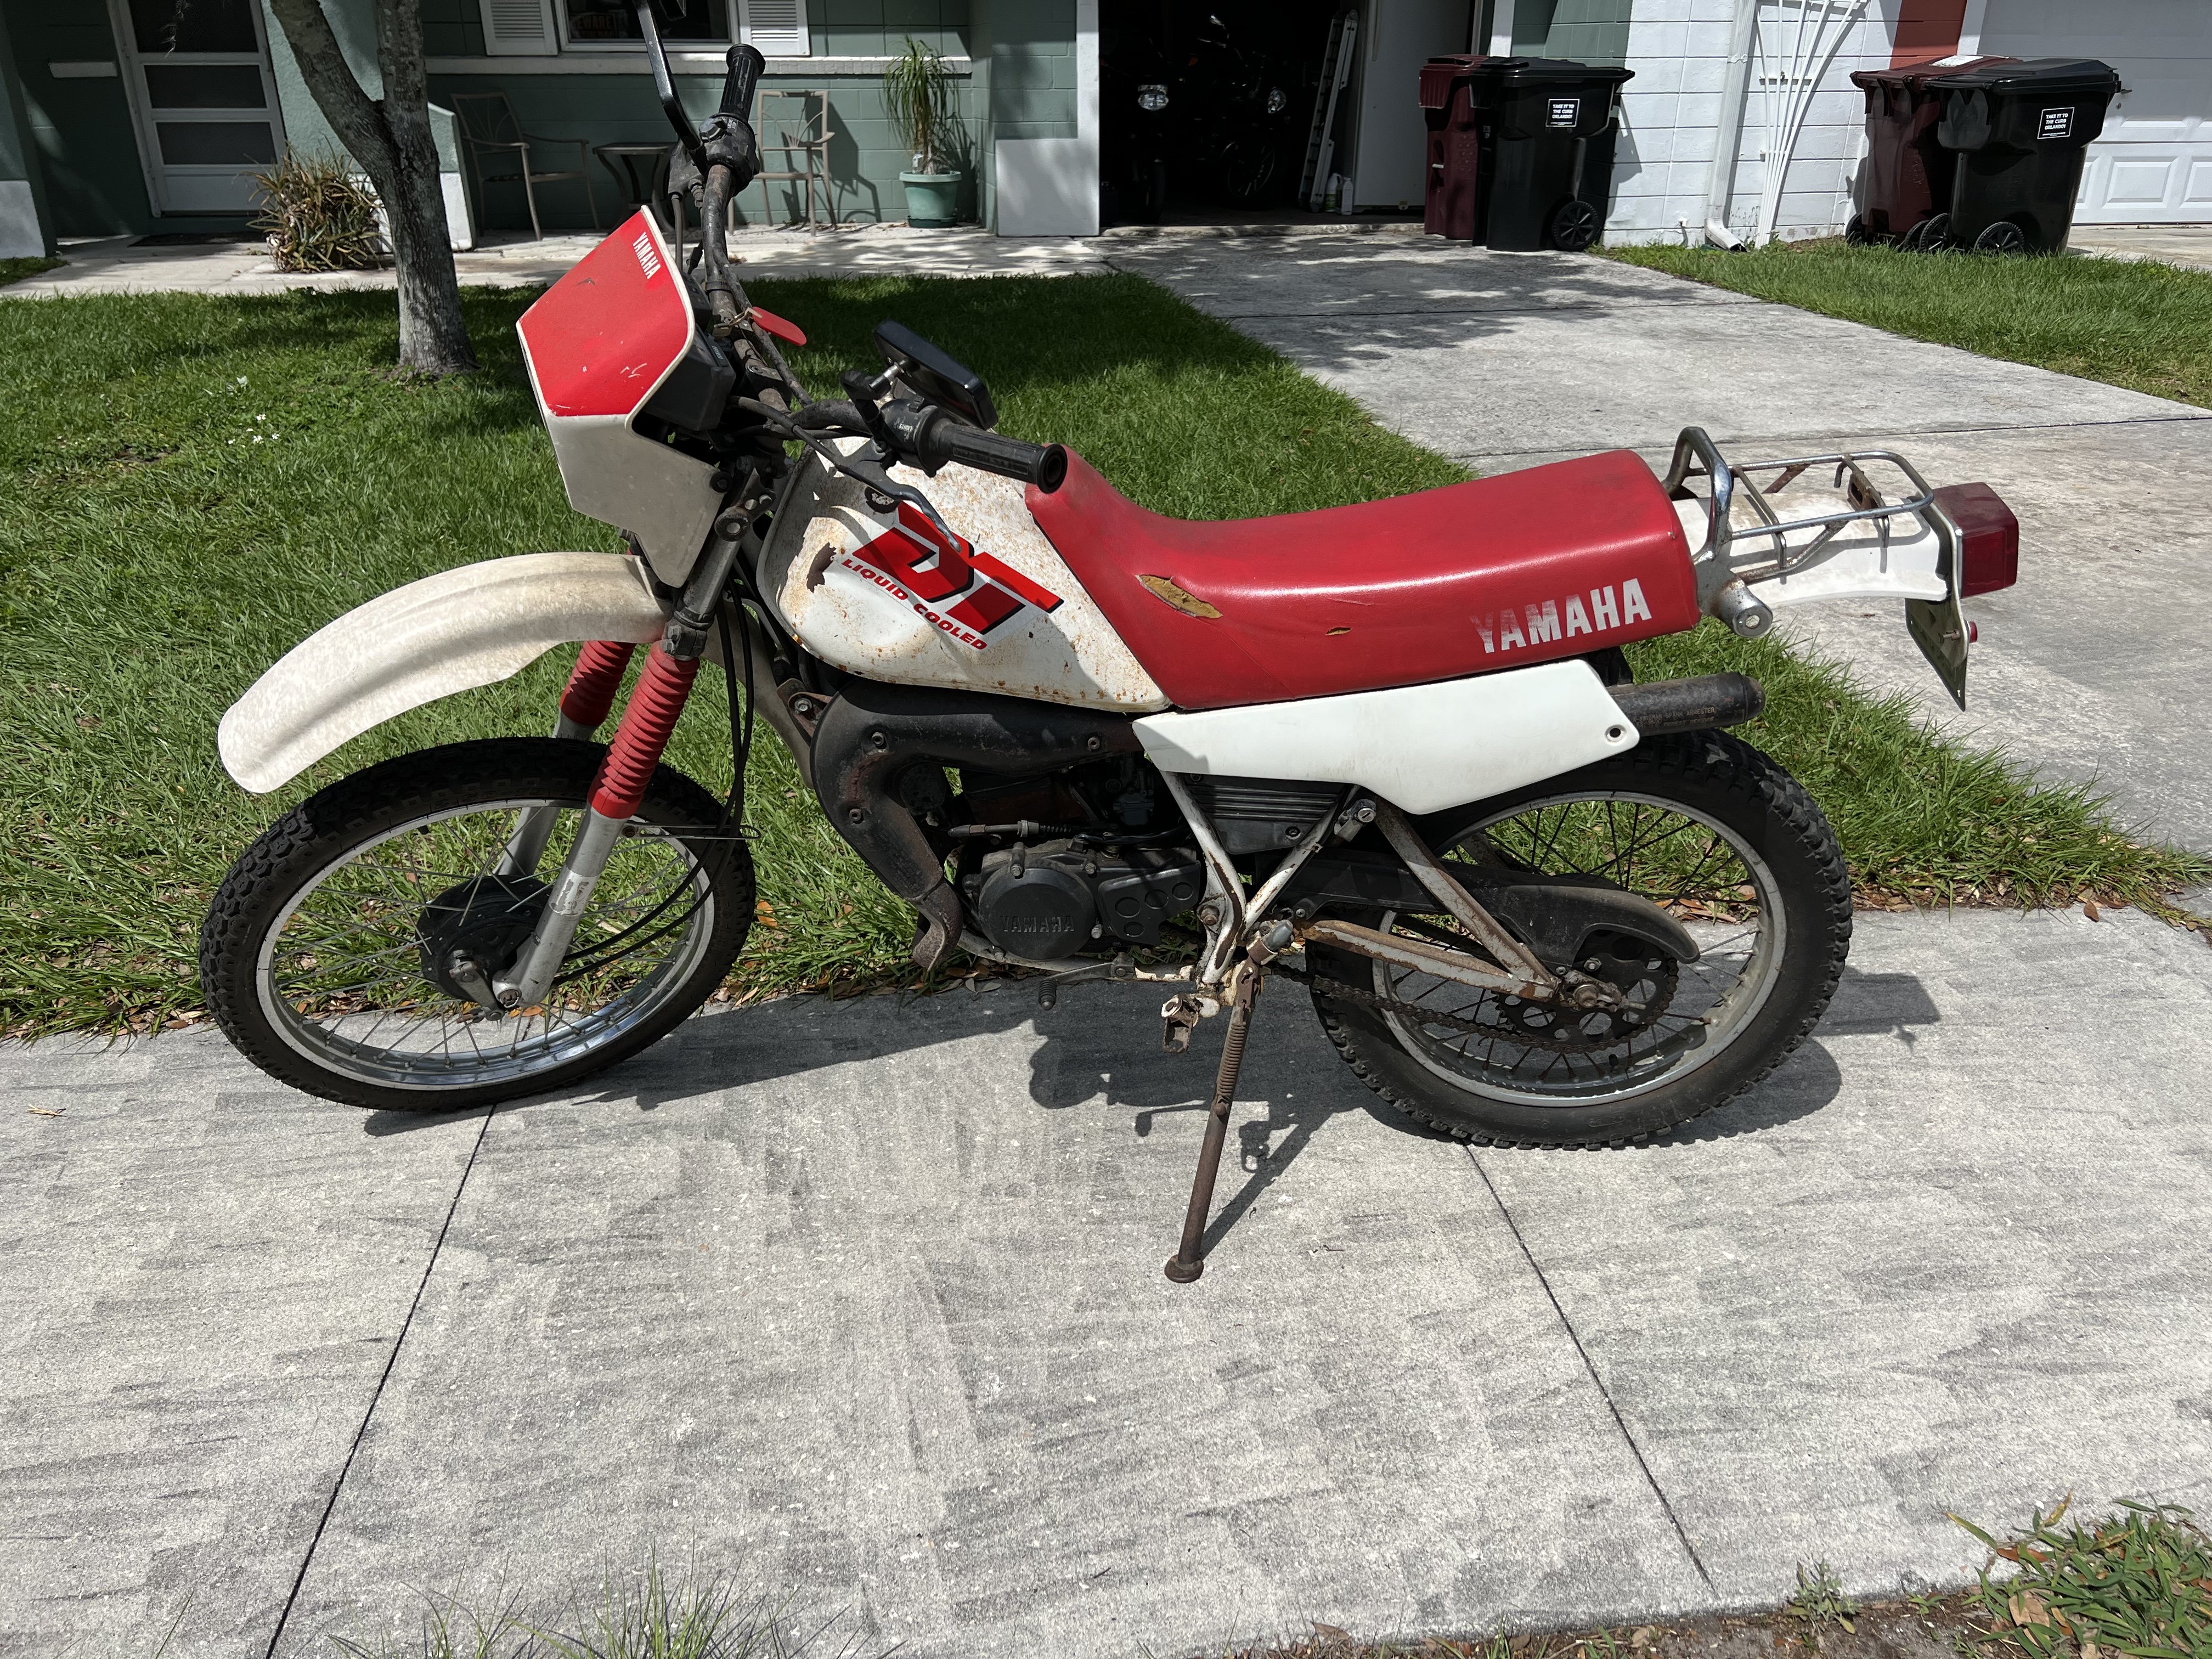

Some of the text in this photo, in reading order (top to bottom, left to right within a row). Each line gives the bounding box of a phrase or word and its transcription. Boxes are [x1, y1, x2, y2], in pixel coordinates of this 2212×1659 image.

[633, 232, 661, 279] YAMAHA
[840, 558, 988, 650] LIQUID COOLED
[1468, 577, 1652, 654] YAMAHA
[1000, 915, 1075, 933] YAMAHA
